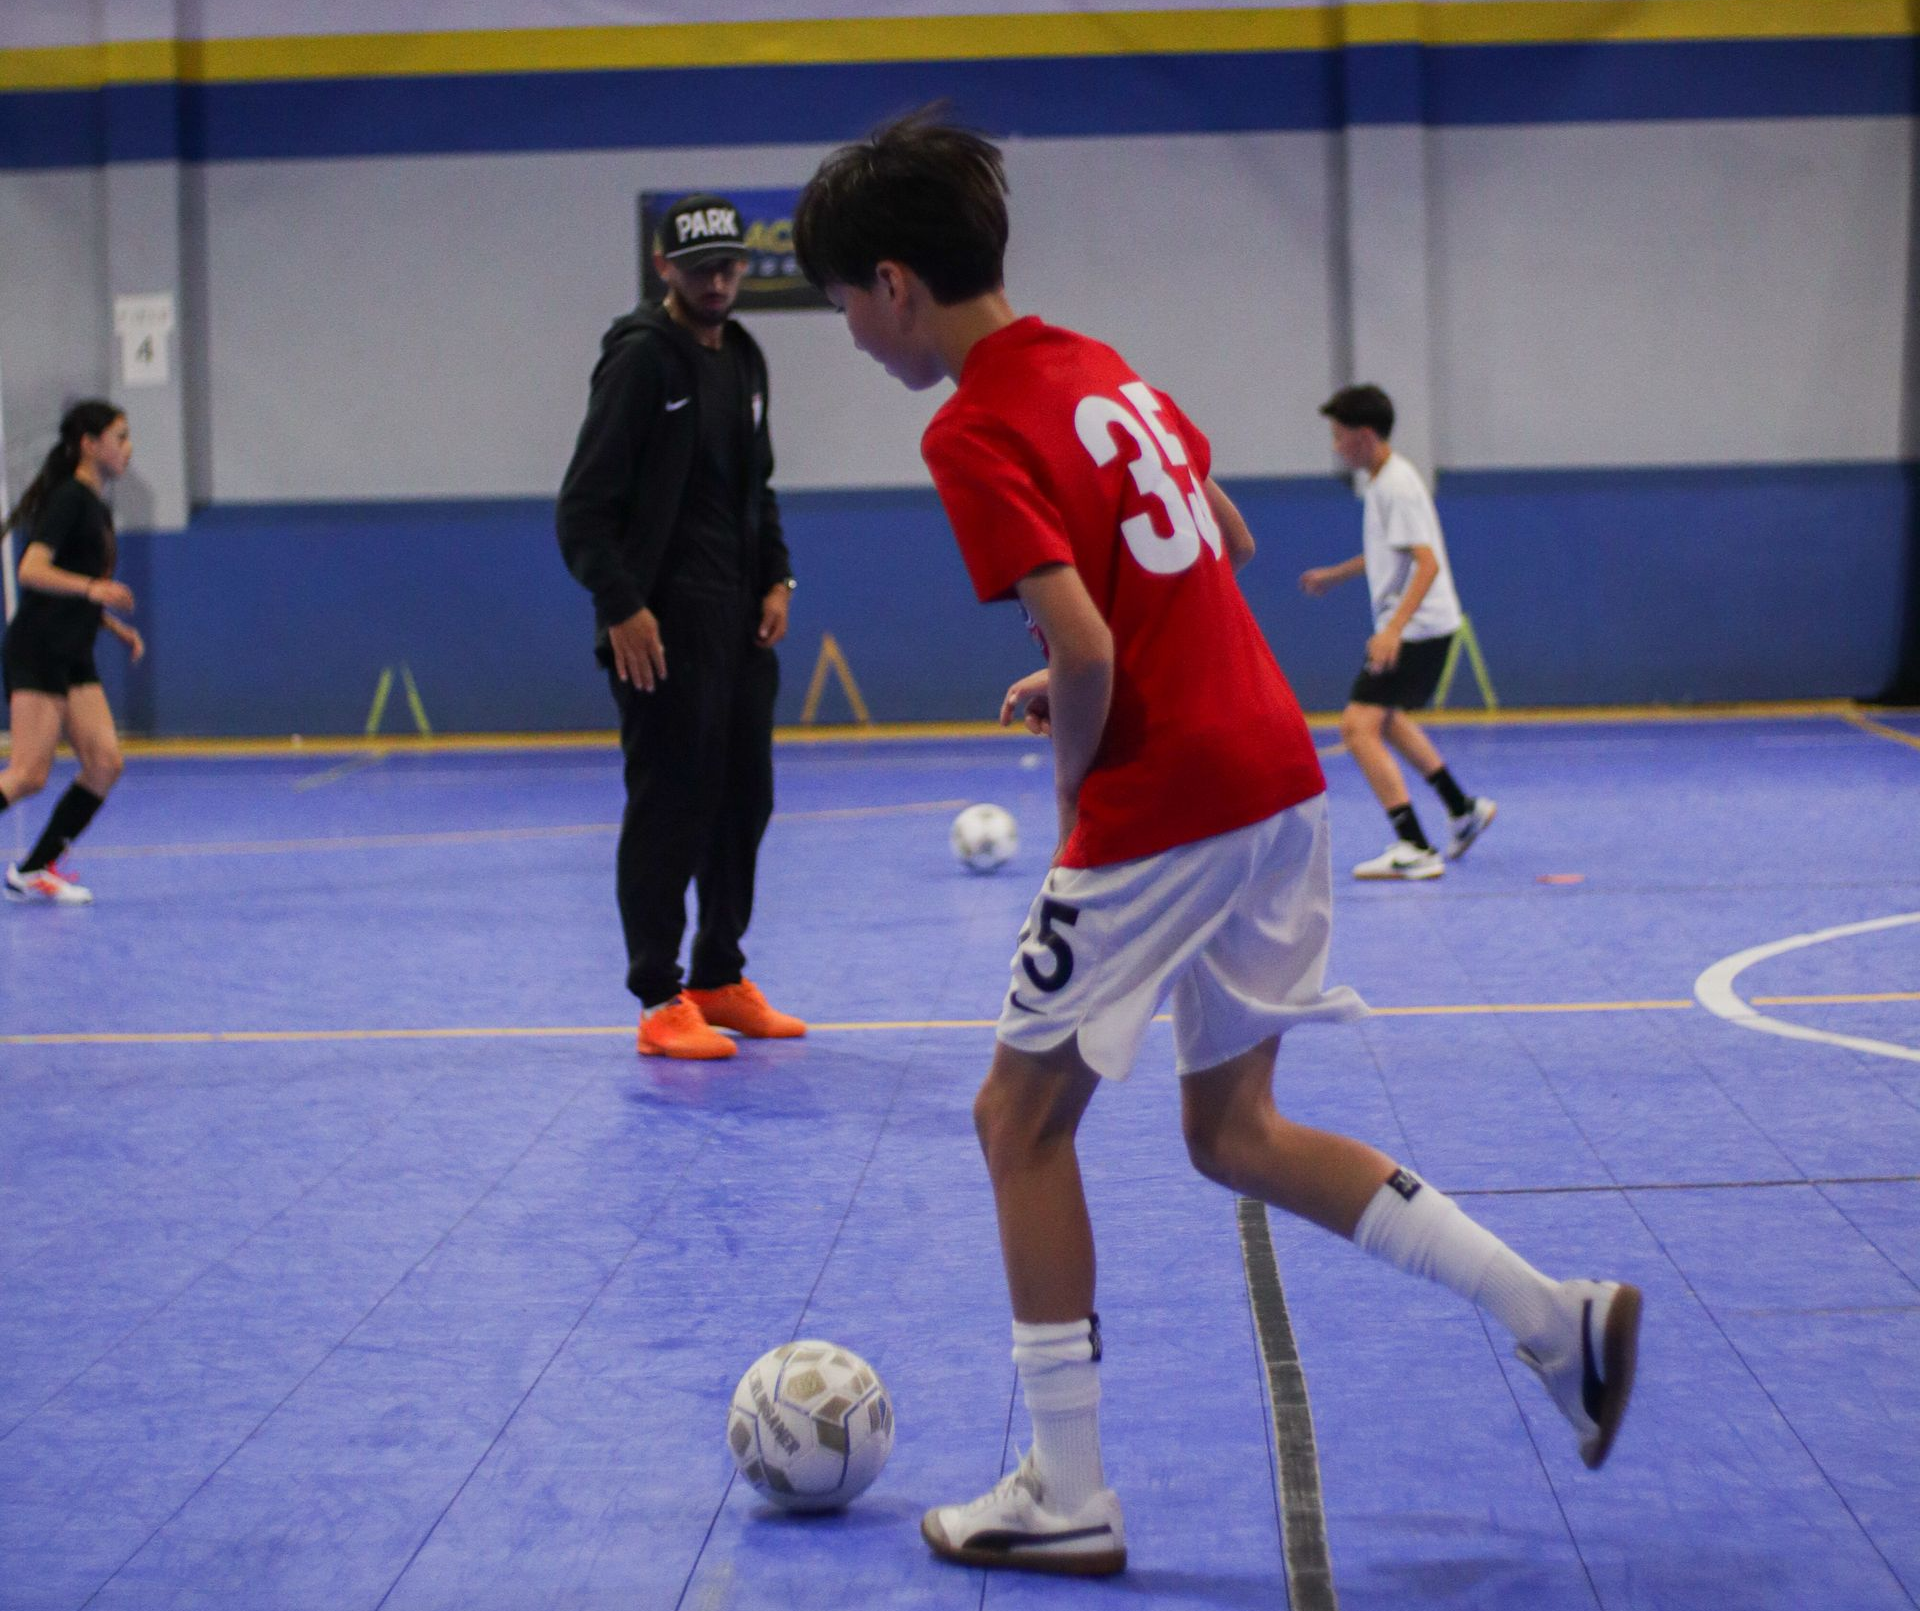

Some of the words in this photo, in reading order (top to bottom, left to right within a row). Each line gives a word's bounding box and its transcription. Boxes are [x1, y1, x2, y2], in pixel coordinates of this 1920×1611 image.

[675, 207, 739, 244] PARK
[134, 333, 154, 363] 4
[1074, 381, 1222, 575] 35
[1017, 899, 1080, 993] 5
